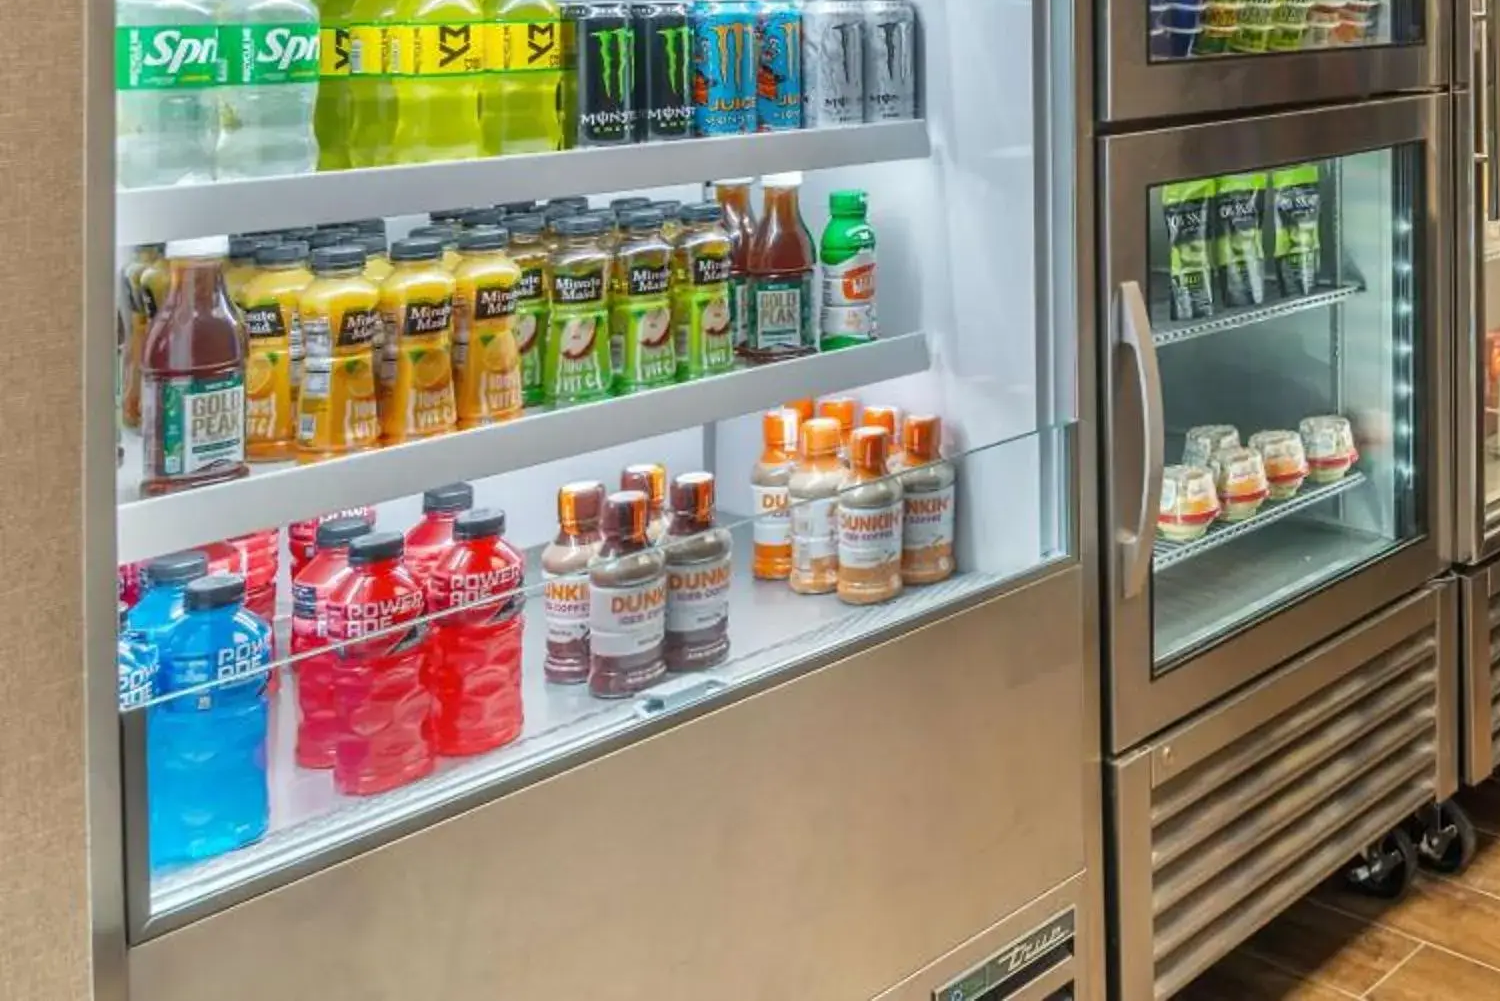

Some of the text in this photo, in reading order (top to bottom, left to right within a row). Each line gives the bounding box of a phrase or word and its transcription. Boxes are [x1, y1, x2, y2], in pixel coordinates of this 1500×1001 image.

[555, 277, 600, 290] Minute
[562, 287, 596, 301] Maid
[450, 566, 522, 591] POWER
[348, 592, 424, 621] POWER
